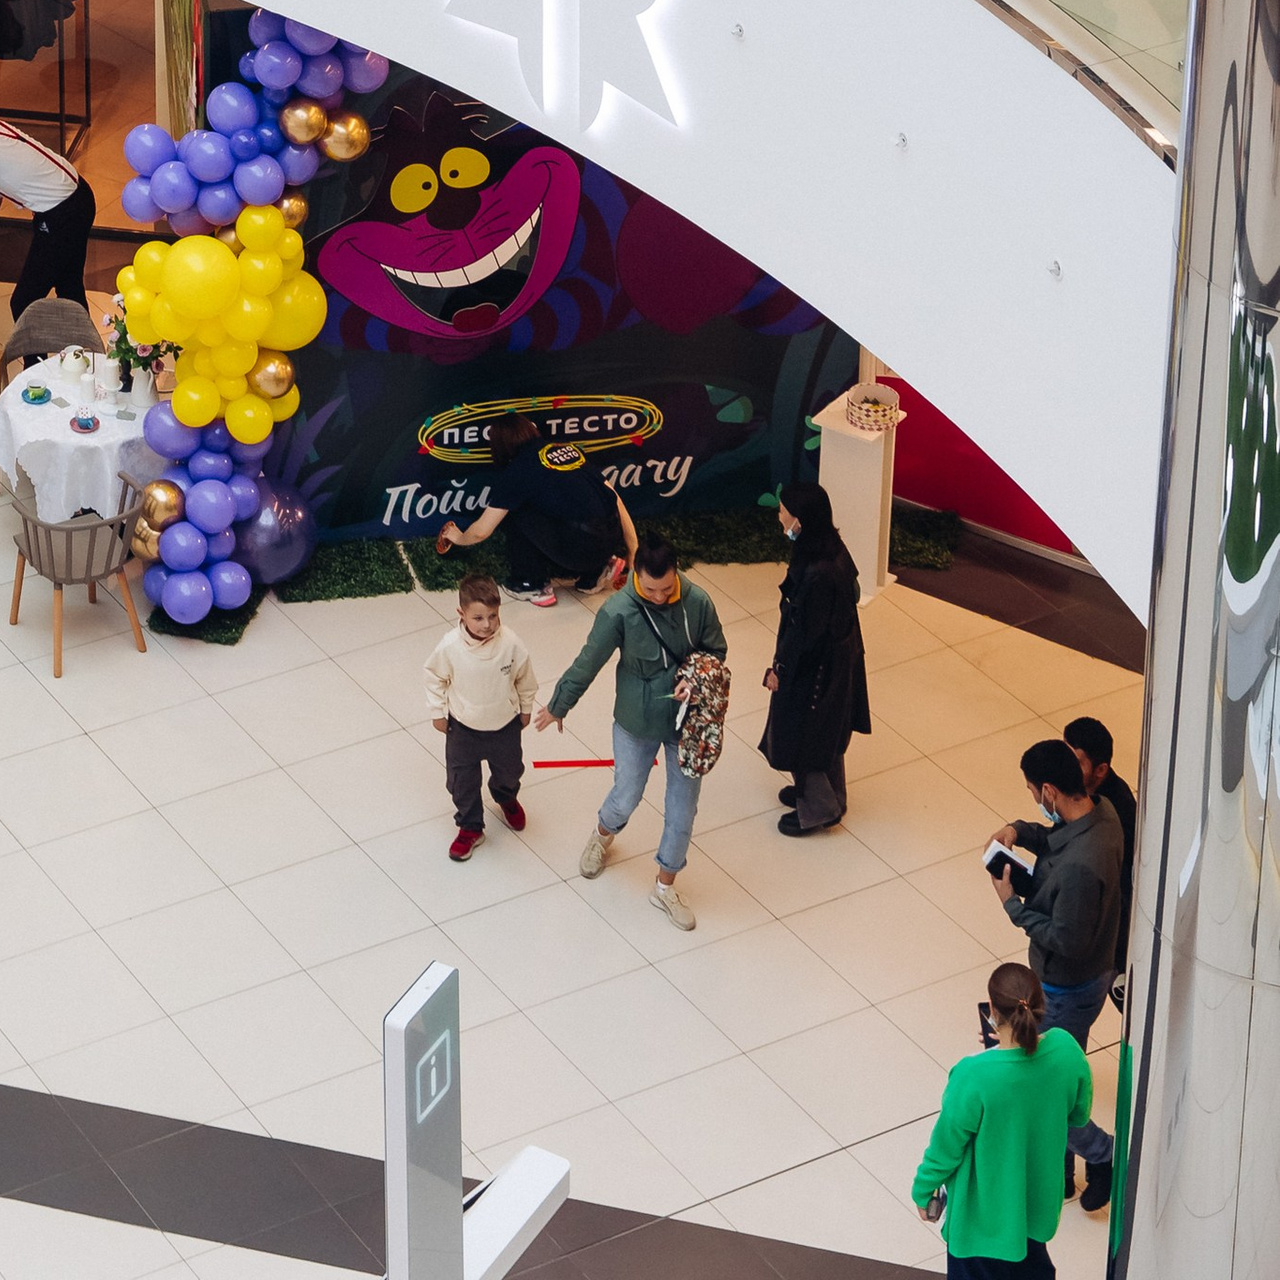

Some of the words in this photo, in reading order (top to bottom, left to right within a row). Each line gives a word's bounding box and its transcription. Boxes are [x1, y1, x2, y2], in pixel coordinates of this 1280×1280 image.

[546, 412, 638, 436] ТЕСТО
[547, 446, 573, 460] ПЕСТО
[553, 451, 579, 464] ТЕСТО
